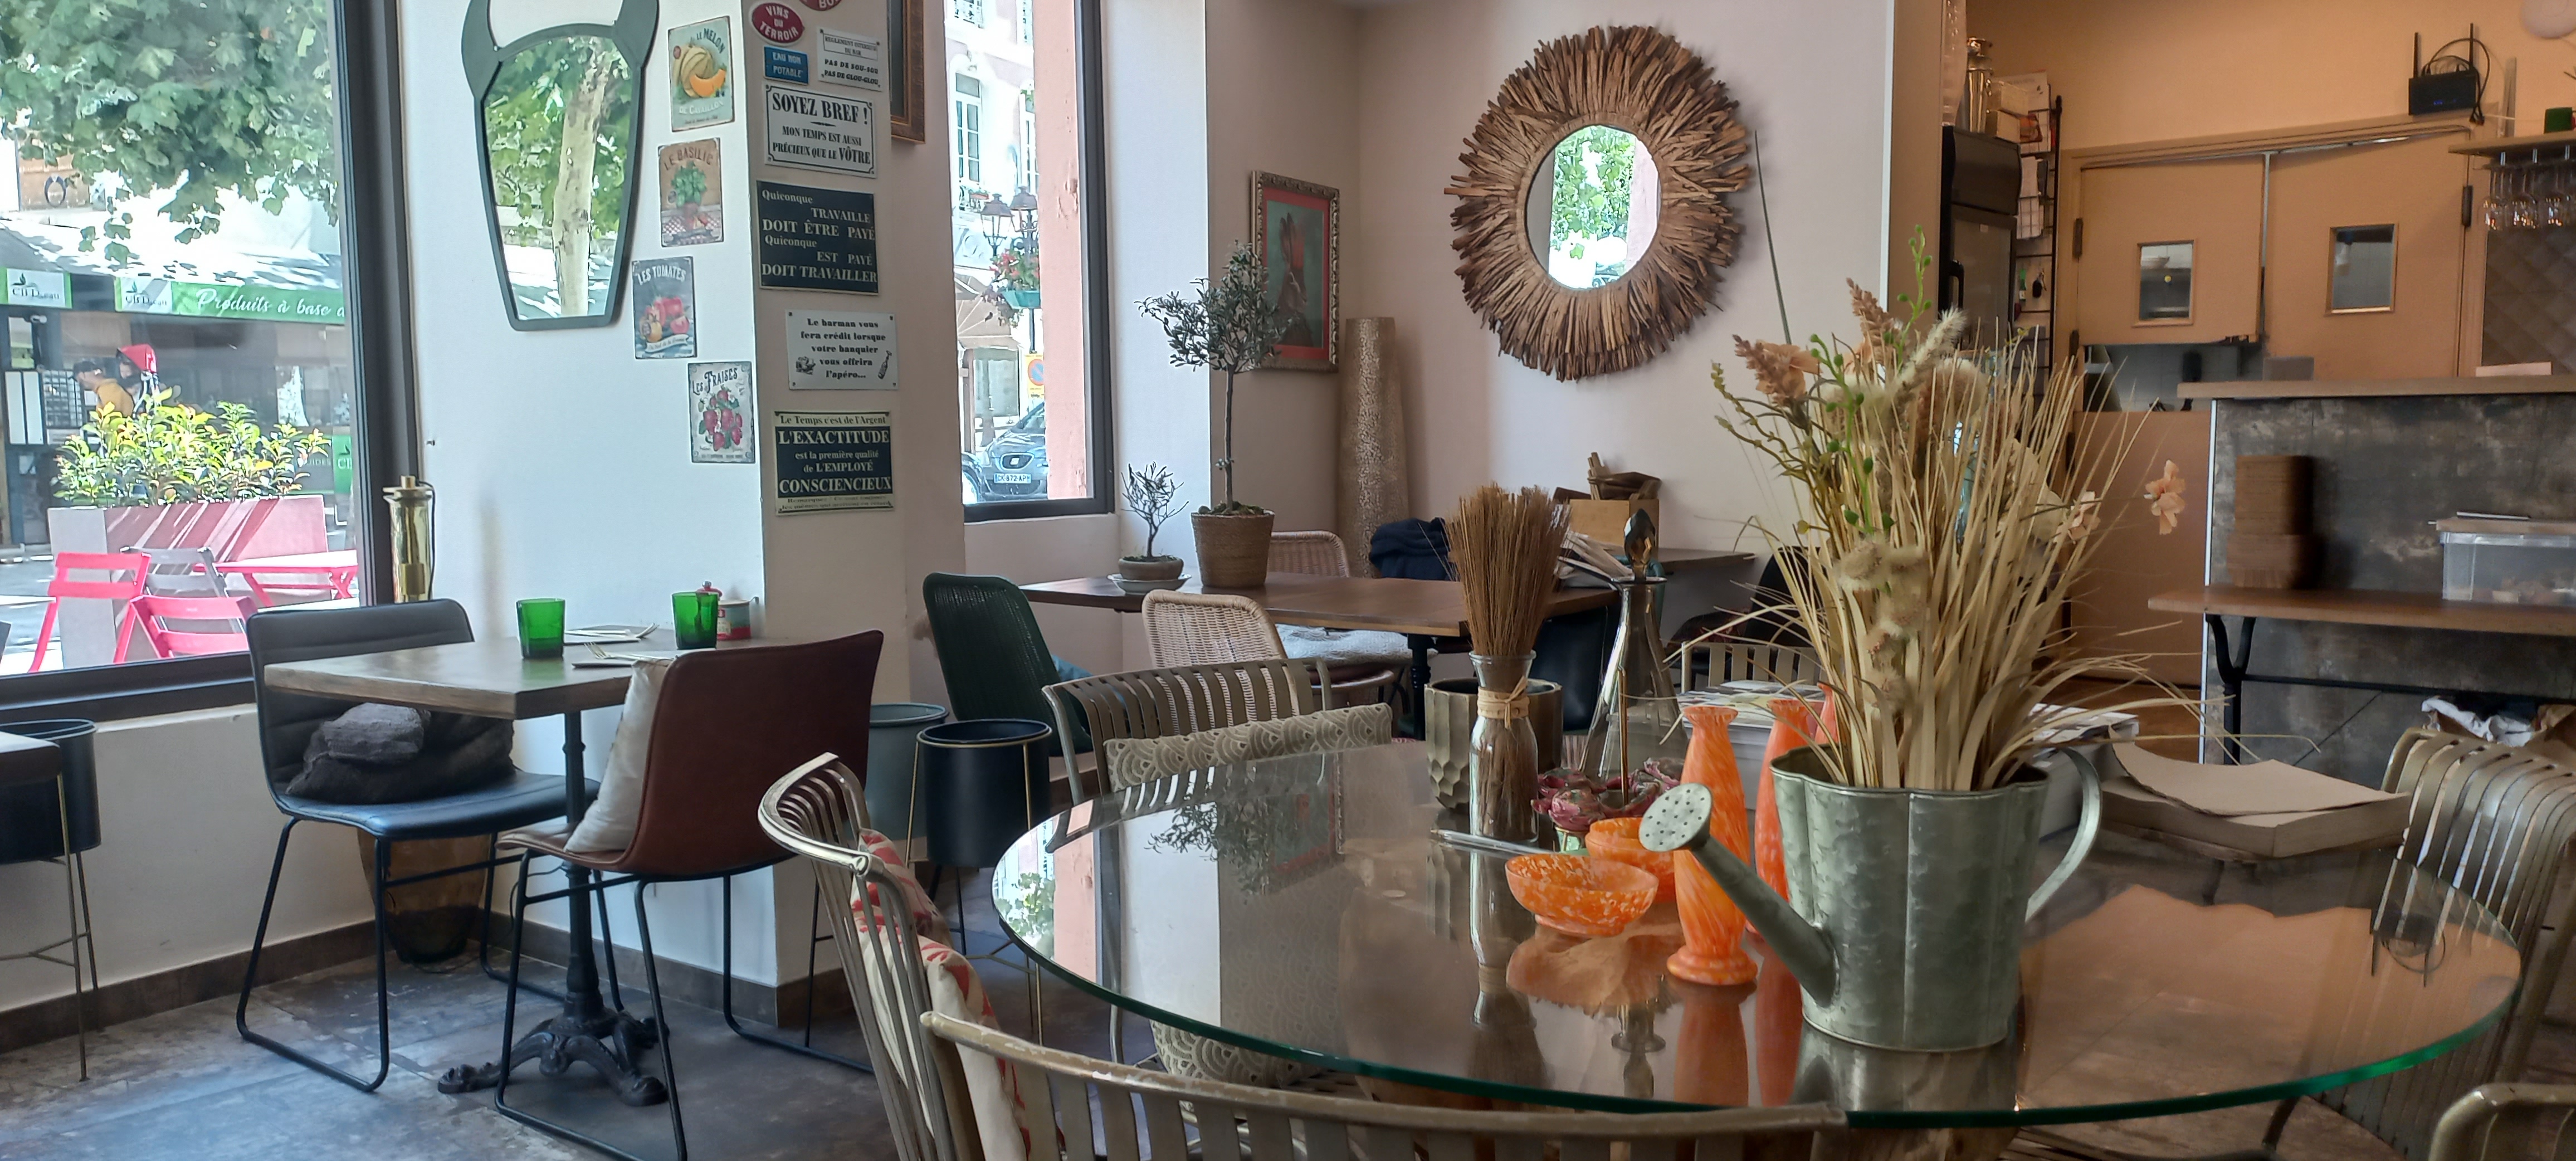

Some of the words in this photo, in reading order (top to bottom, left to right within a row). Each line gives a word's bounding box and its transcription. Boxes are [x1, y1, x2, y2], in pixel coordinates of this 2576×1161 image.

[765, 6, 789, 19] VINS
[774, 18, 783, 27] DU
[759, 21, 799, 41] TERROIR
[696, 32, 702, 40] LE
[703, 28, 725, 54] MELON
[772, 52, 786, 62] EAU
[788, 53, 802, 65] NON
[773, 65, 803, 78] POTABLE
[846, 74, 879, 85] GLOU-GLOU
[772, 92, 818, 116] SOYEZ
[821, 100, 858, 123] BREF
[782, 125, 801, 136] MON
[802, 128, 827, 141] TEMPS
[828, 133, 841, 143] EST
[842, 134, 862, 146] AUSSI
[663, 156, 675, 170] LE
[677, 147, 714, 165] BASILIC
[773, 142, 810, 156] PRÉCIEUX
[811, 148, 826, 158] QUE
[828, 150, 837, 159] LE
[838, 146, 871, 164] VÔTRE
[762, 189, 813, 204] Quiconque
[811, 207, 870, 223] TRAVAILLE
[763, 219, 798, 233] DOIT
[804, 219, 840, 236] ÊTRE
[847, 226, 875, 240] PAYÉ
[764, 235, 818, 249] Quiconque
[817, 251, 838, 263] EST
[848, 253, 872, 266] PAYÉ
[637, 268, 651, 286] LES
[652, 265, 686, 282] TOMATES
[762, 264, 797, 277] DOIT
[799, 265, 877, 282] TRAVAILLER
[196, 288, 270, 313] Produits
[277, 300, 290, 313] à
[296, 298, 333, 315] base
[822, 319, 856, 328] barman
[823, 331, 851, 340] crédit
[853, 332, 886, 342] lorsque
[838, 344, 879, 355] banquier
[780, 415, 792, 424] Le
[795, 416, 823, 426] Temps
[824, 416, 843, 424] c'est
[844, 416, 853, 424] de
[855, 416, 886, 425] l'Argent
[778, 430, 889, 445] L'EXACTITUDE
[809, 451, 817, 459] la
[818, 450, 853, 461] première
[855, 450, 879, 460] qualité
[803, 465, 814, 473] de
[816, 459, 874, 472] L'EMPLOYÉ
[779, 476, 891, 494] CONSCIENCIEUX
